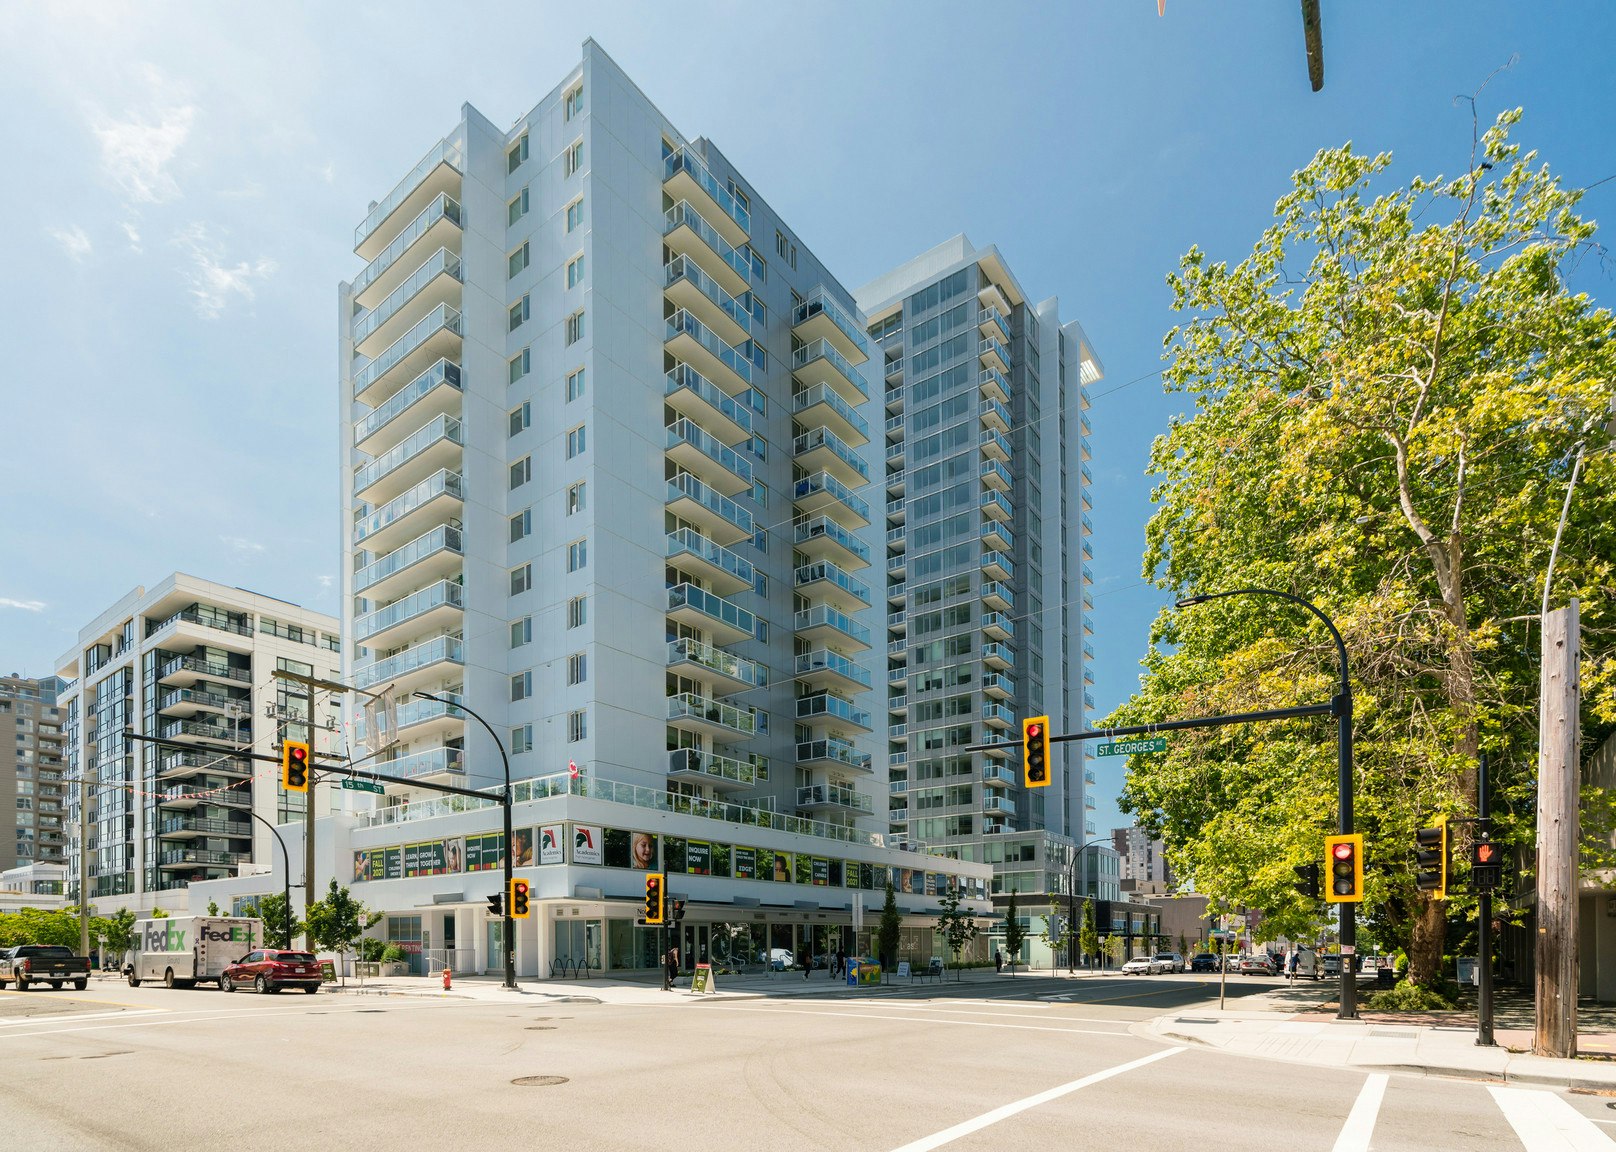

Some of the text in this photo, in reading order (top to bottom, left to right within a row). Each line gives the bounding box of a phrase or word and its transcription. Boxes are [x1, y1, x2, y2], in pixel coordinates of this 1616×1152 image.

[1098, 745, 1111, 756] ST.
[1113, 741, 1155, 754] GEORGES
[345, 781, 354, 789] 15
[373, 785, 382, 794] ST
[420, 850, 433, 859] GROW
[688, 846, 709, 855] INQUIRE
[420, 859, 441, 867] TOGETHER
[688, 855, 702, 863] NOW
[372, 860, 384, 868] FALL
[372, 868, 384, 877] 2021
[846, 869, 858, 878] FALL
[846, 878, 858, 886] 2021
[145, 920, 186, 952] FedEx
[200, 925, 257, 942] FedEx
